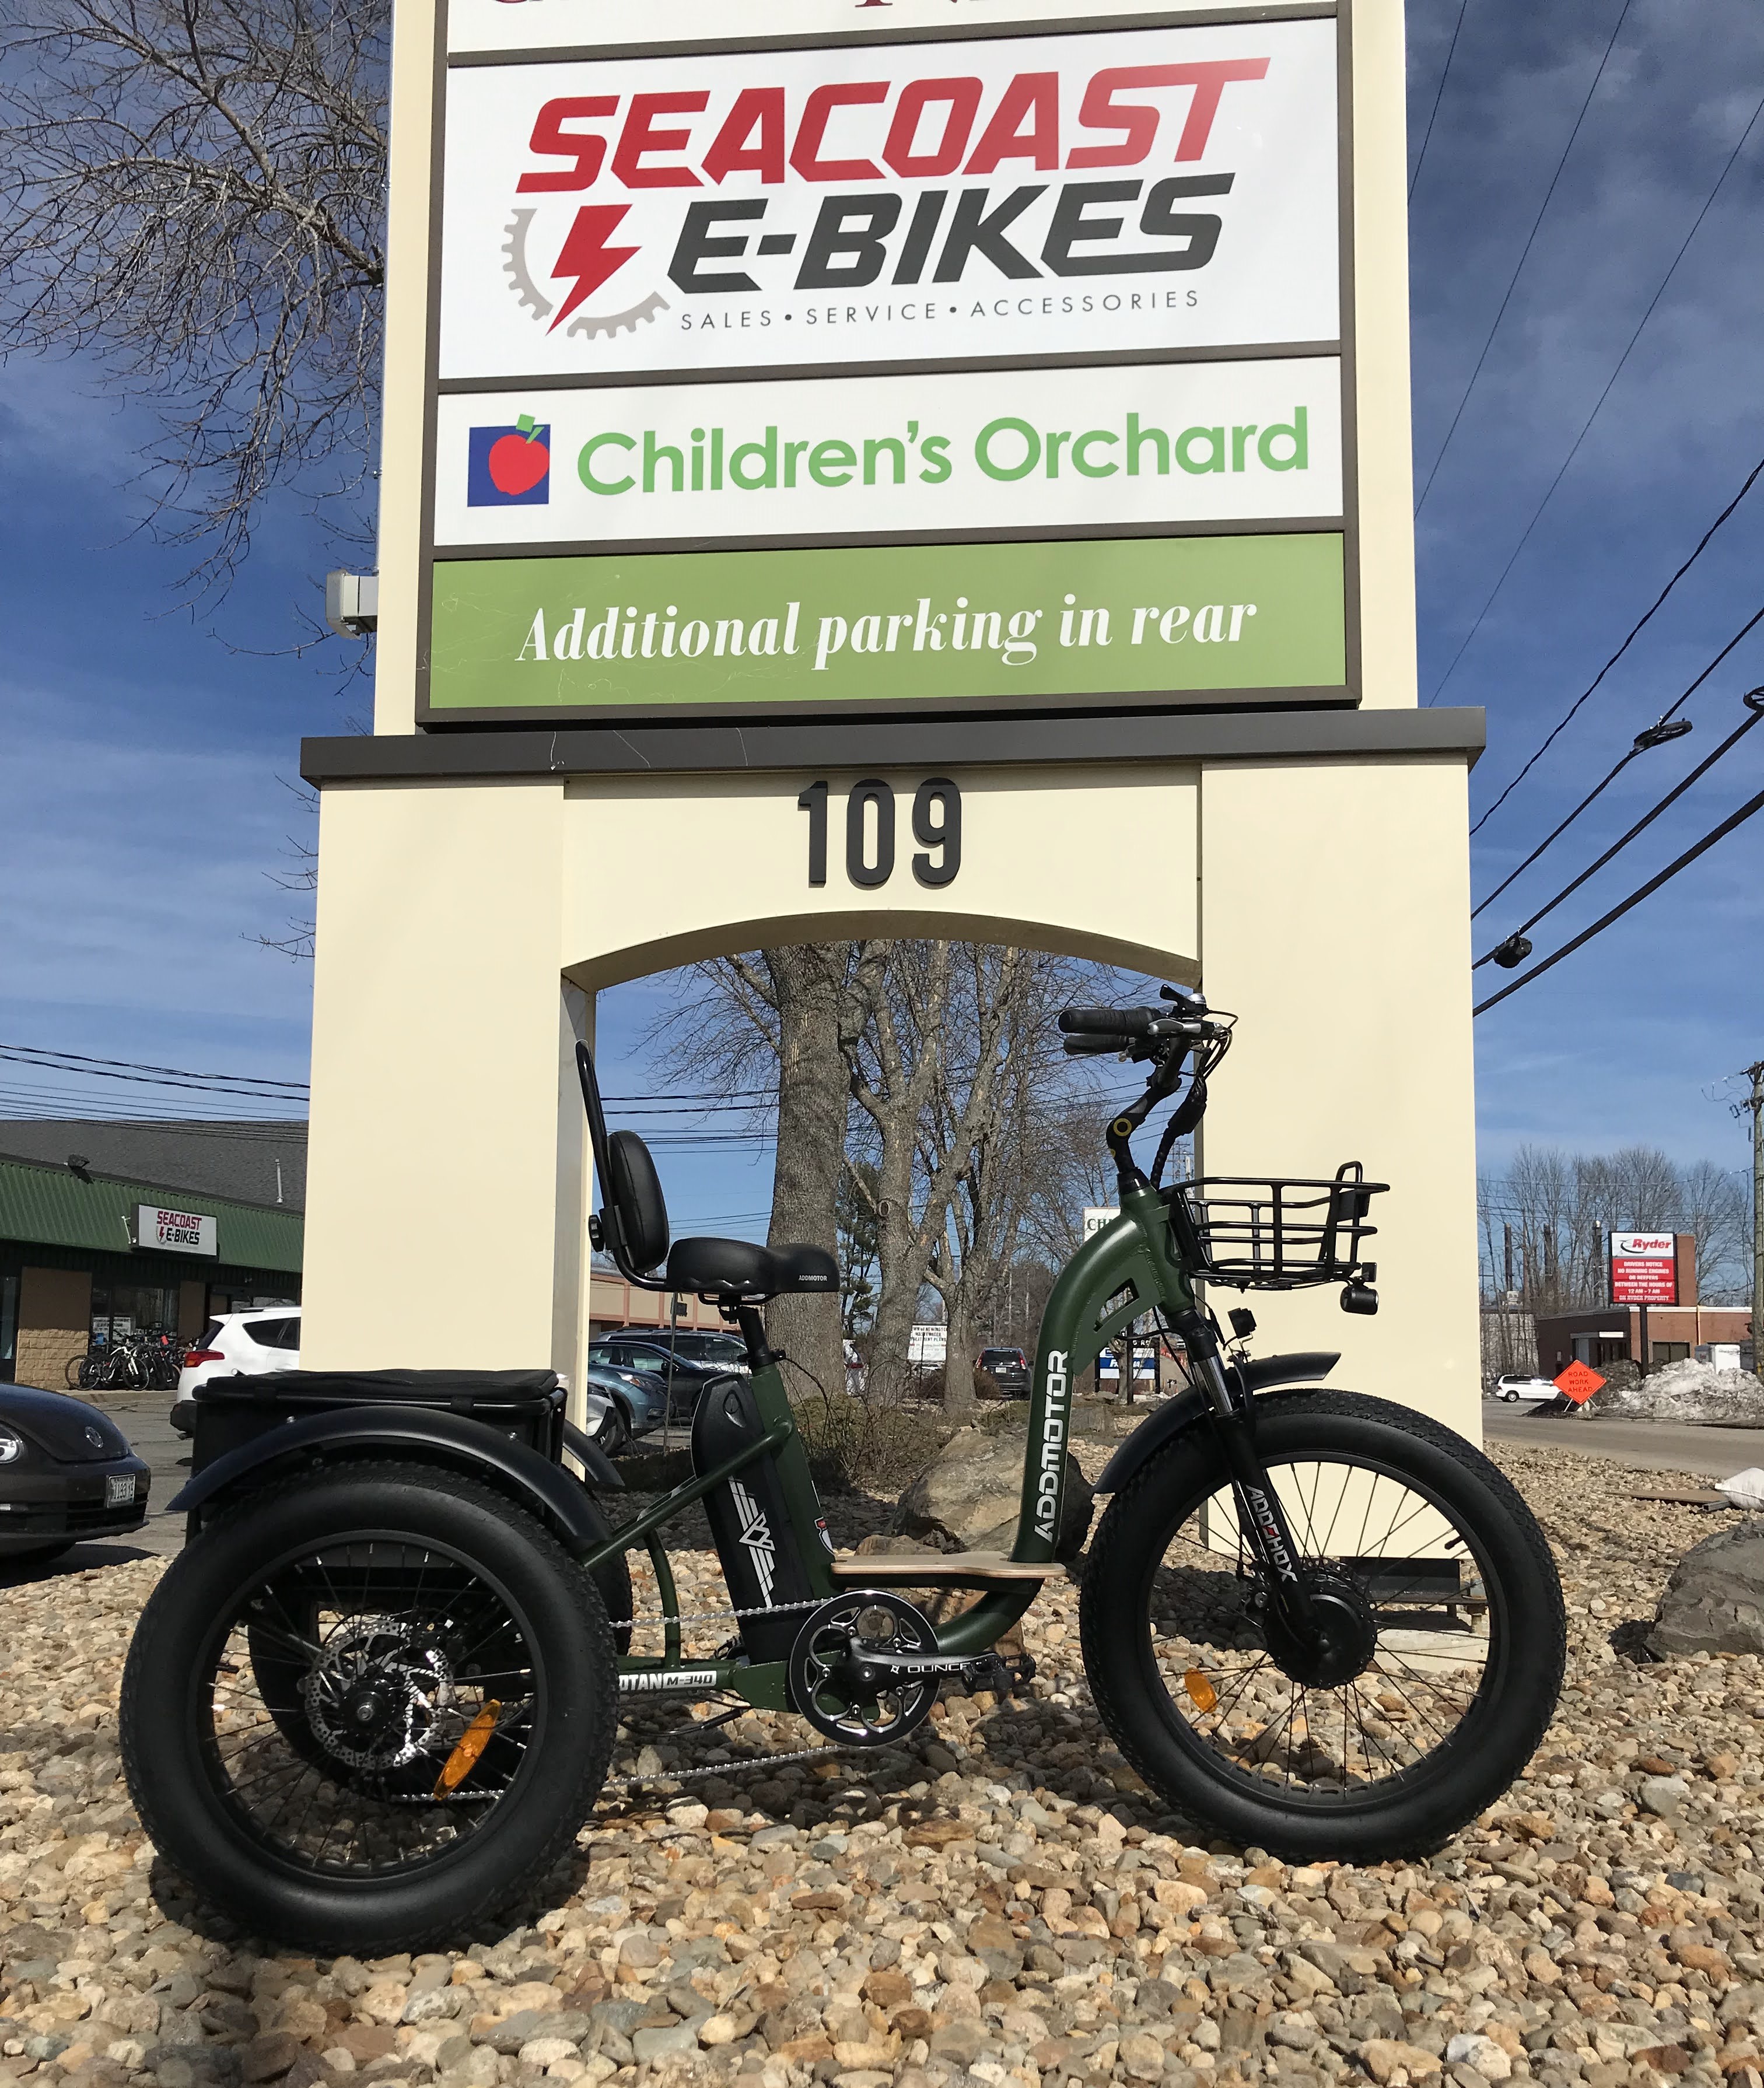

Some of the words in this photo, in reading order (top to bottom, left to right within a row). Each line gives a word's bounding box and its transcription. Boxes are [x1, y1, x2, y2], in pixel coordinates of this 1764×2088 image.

[516, 57, 1270, 193] SEACOAST
[667, 173, 1236, 294] E-BIKES
[681, 310, 771, 330] SALES
[806, 303, 935, 325] SERVICE
[970, 290, 1198, 317] ACCESSORIES
[578, 421, 952, 496] Children's
[975, 406, 1308, 482] Orchard
[514, 601, 801, 661] Additional
[811, 597, 1043, 671] parking
[1059, 593, 1113, 647] in
[1130, 601, 1258, 645] rear
[798, 777, 962, 887] 109
[156, 1211, 202, 1230] SEACOAST
[166, 1227, 200, 1245] E-BIKES
[1632, 1238, 1672, 1250] Ryder
[1034, 1350, 1069, 1543] ADDMOTOR
[618, 1673, 663, 1691] OTAN
[666, 1674, 713, 1686] M-340
